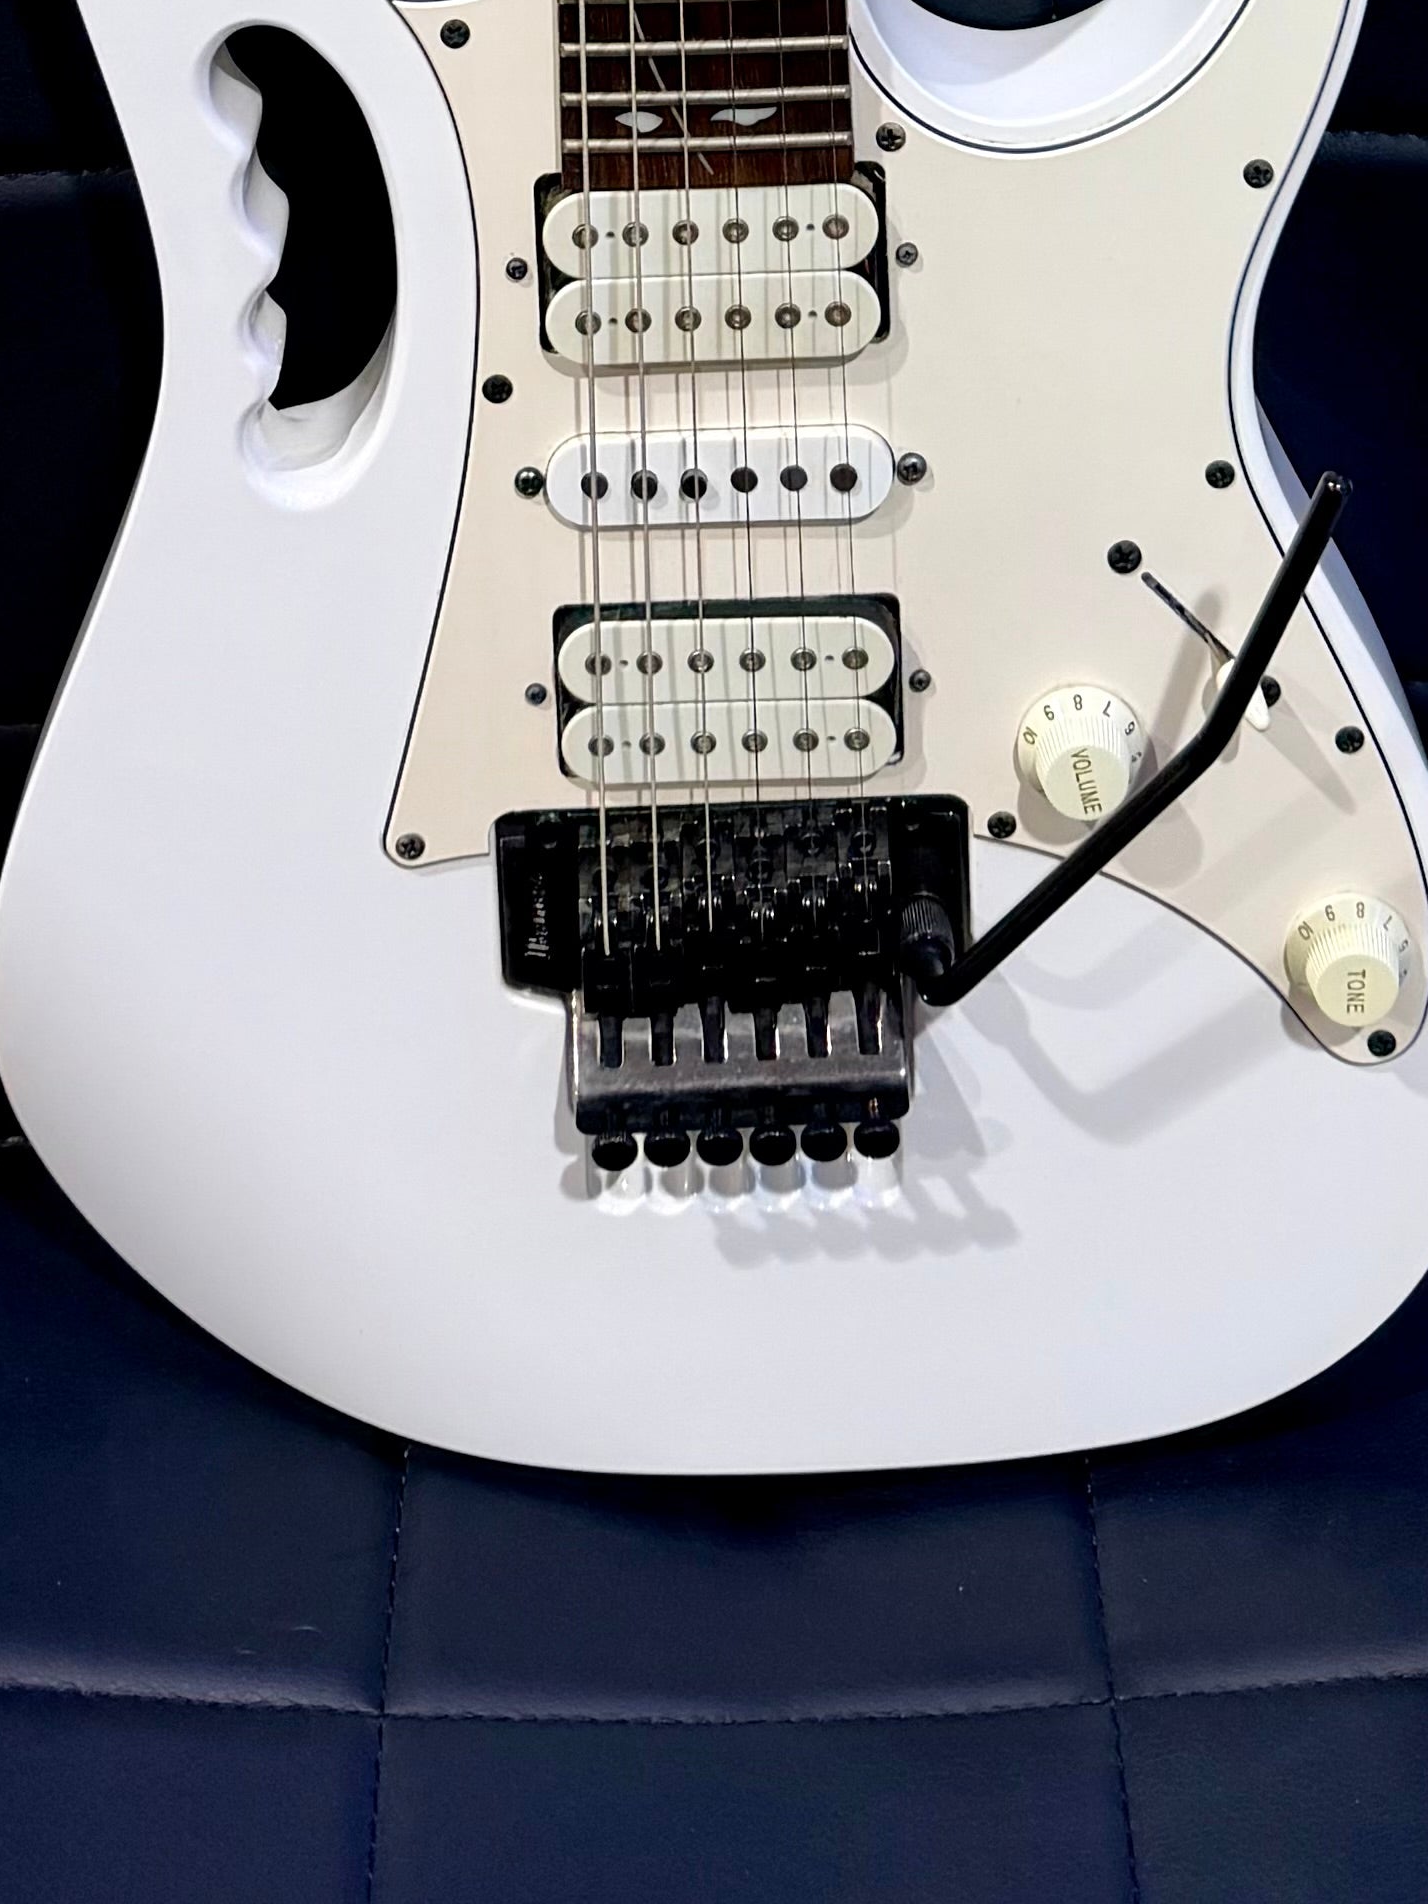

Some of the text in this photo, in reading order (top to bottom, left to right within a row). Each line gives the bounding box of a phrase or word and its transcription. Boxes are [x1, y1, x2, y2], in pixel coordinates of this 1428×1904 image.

[1073, 693, 1083, 711] 8
[1070, 748, 1103, 815] VOLUME
[1355, 901, 1365, 919] 8
[1346, 968, 1366, 1014] TONE
